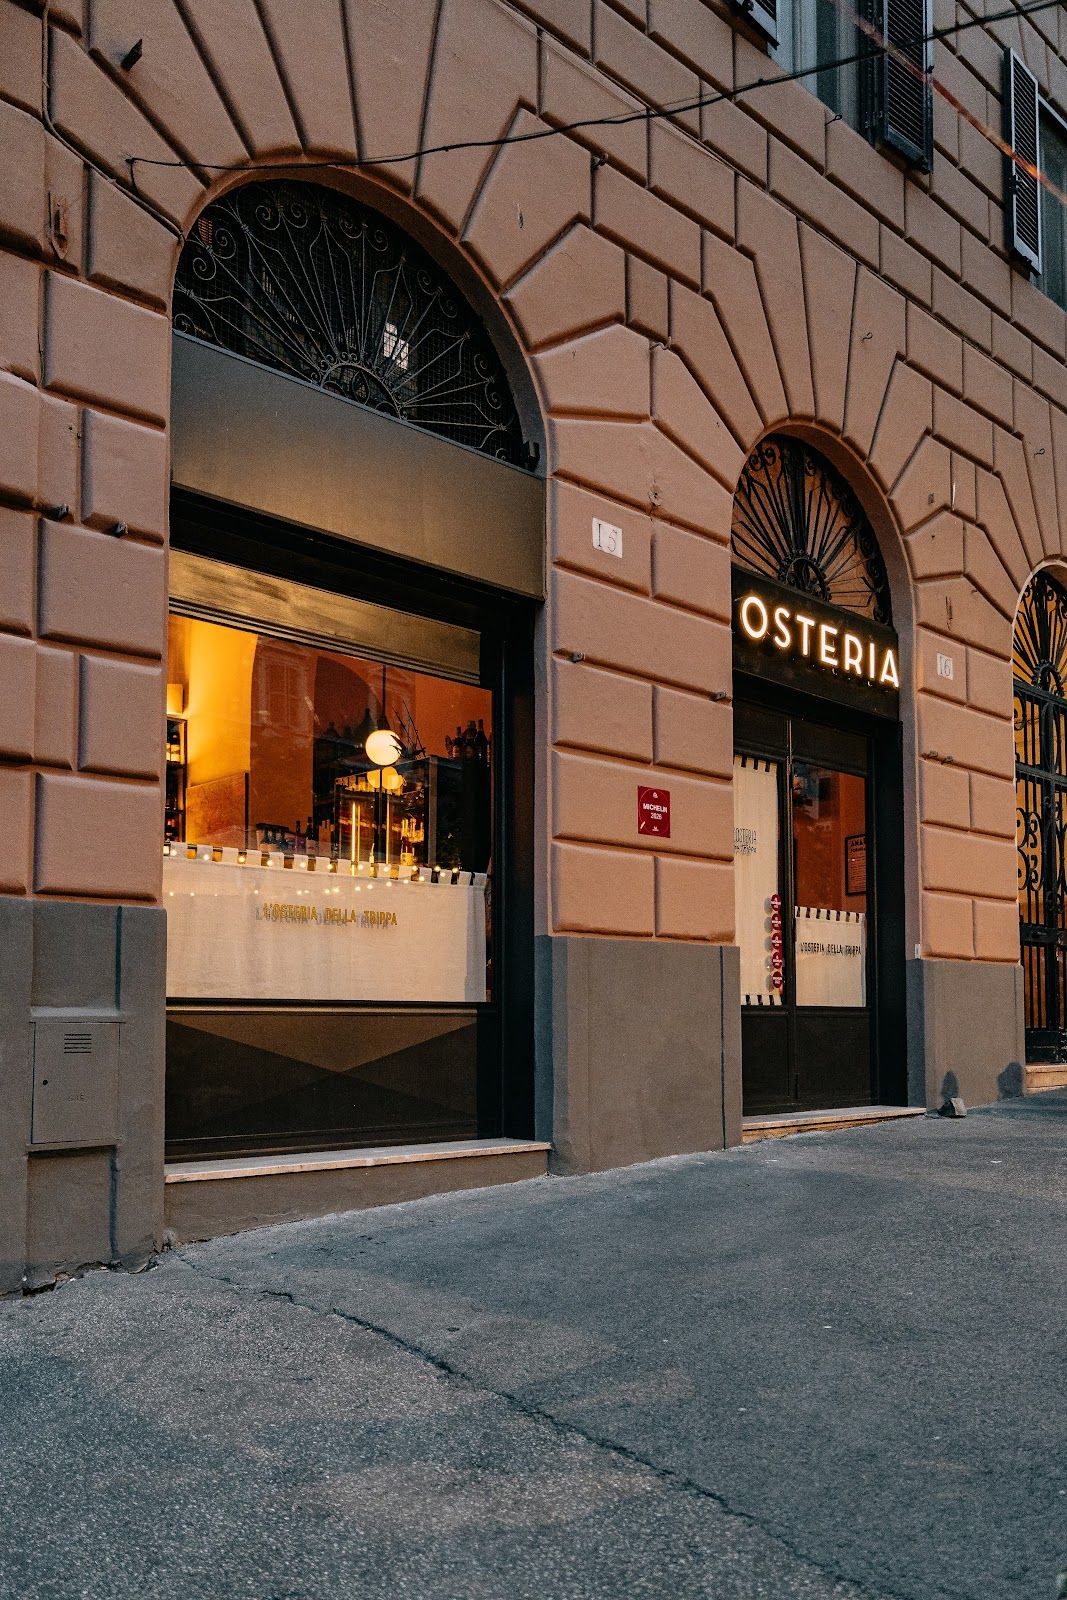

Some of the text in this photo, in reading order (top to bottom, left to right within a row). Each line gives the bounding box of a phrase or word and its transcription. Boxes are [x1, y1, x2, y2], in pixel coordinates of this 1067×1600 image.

[597, 523, 618, 552] 15
[741, 596, 899, 688] OSTERIA
[940, 655, 951, 677] 16
[642, 803, 668, 813] MICHELIN
[262, 903, 398, 926] L'OSTERIA DELLA TRIPPA
